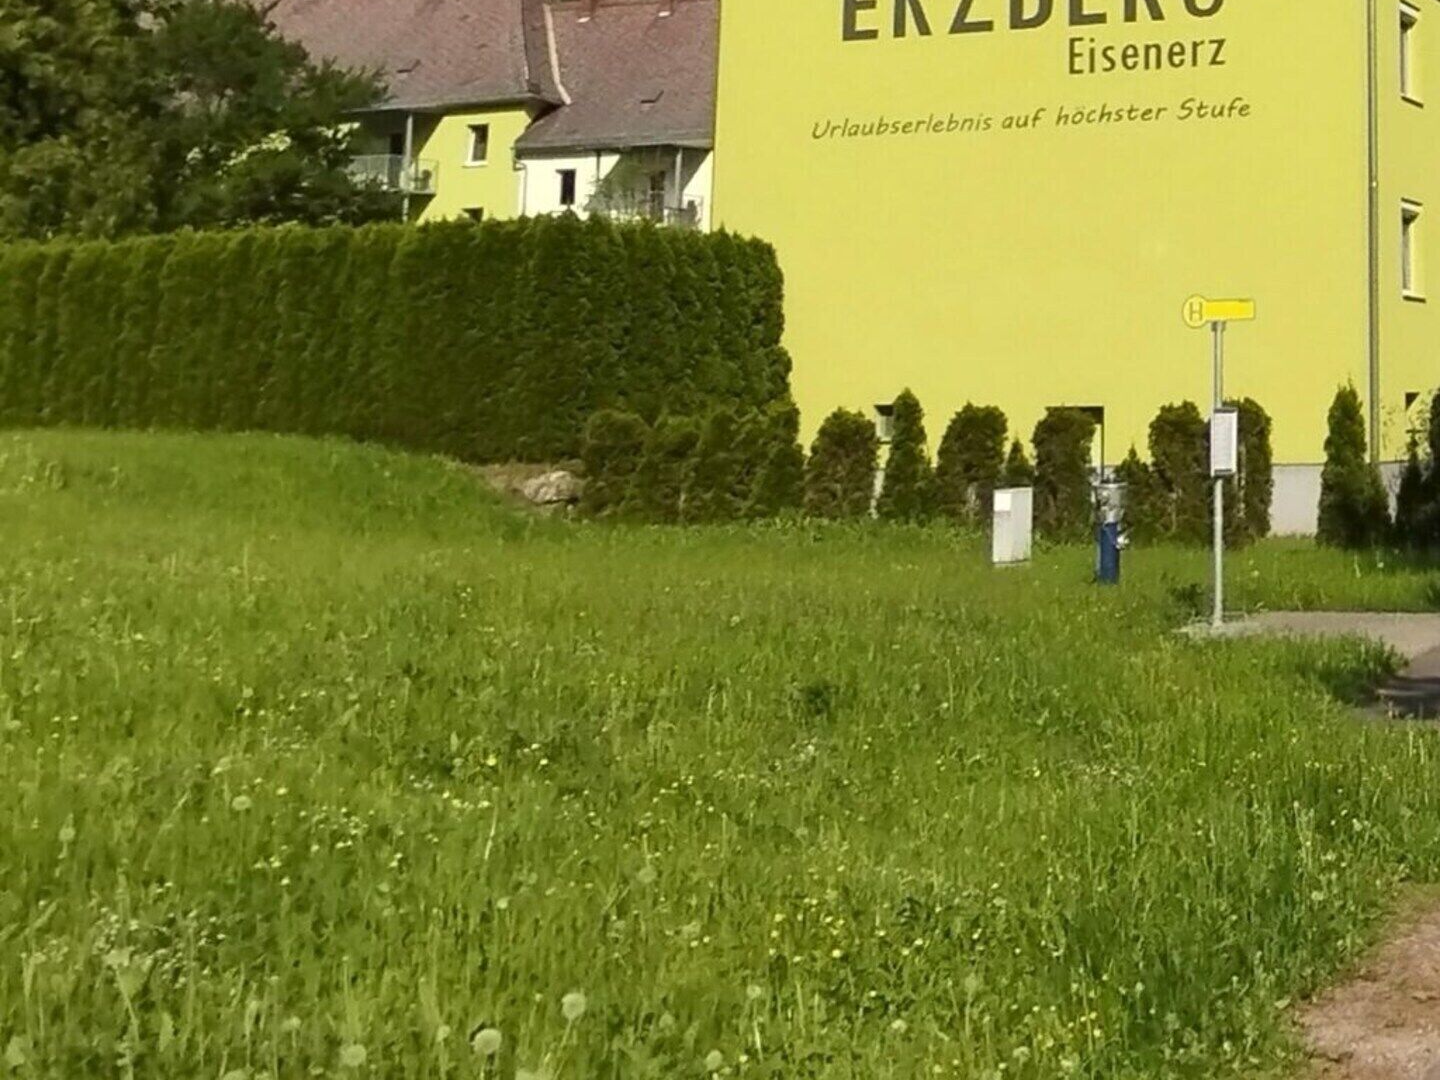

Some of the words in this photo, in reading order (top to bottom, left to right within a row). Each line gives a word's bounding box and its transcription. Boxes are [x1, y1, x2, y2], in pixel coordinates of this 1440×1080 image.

[1068, 37, 1227, 75] Eisenerz
[811, 113, 993, 140] Urlaubserlebnis
[1000, 107, 1047, 129] auf
[1055, 102, 1168, 127] höchster
[1176, 96, 1251, 121] Stufe
[1189, 301, 1203, 321] H
